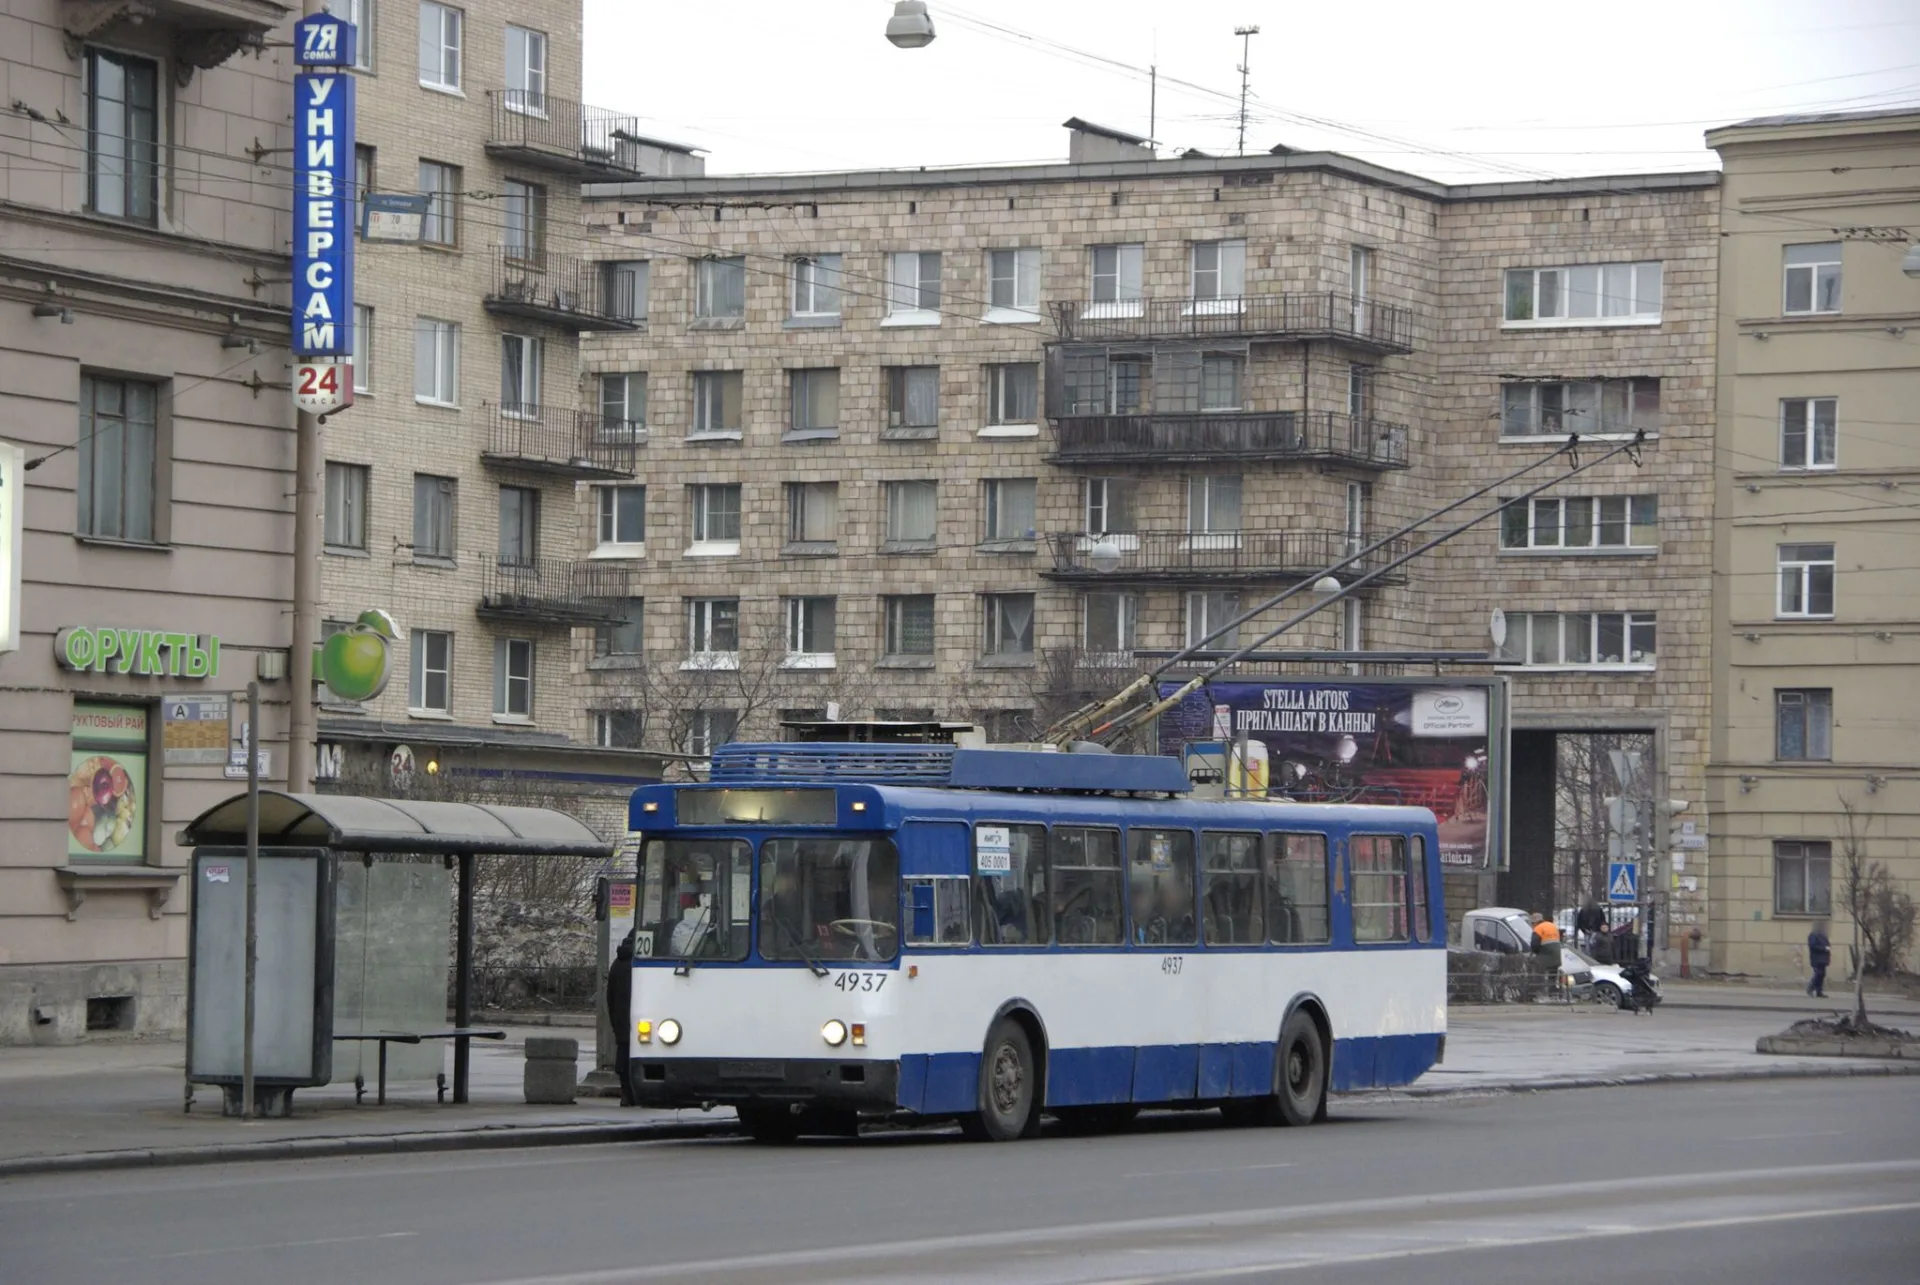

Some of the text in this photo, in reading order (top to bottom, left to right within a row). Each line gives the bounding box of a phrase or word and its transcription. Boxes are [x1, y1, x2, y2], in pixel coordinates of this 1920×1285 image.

[303, 23, 338, 51] 7Я
[303, 78, 335, 349] УНИВЕРСАМ
[298, 366, 338, 394] 24
[66, 626, 220, 678] ФРУКТЫ
[1263, 689, 1350, 710] STELLA ARTOIS
[175, 705, 186, 717] А
[72, 713, 145, 730] РУКТОВЫЙ РАЙ
[1236, 710, 1376, 733] ПРИГЛАШАЕТ В КАННЫ!
[1440, 852, 1473, 865] artois.ru
[636, 936, 651, 956] 20
[1161, 956, 1184, 975] 4937
[834, 972, 888, 992] 4937
